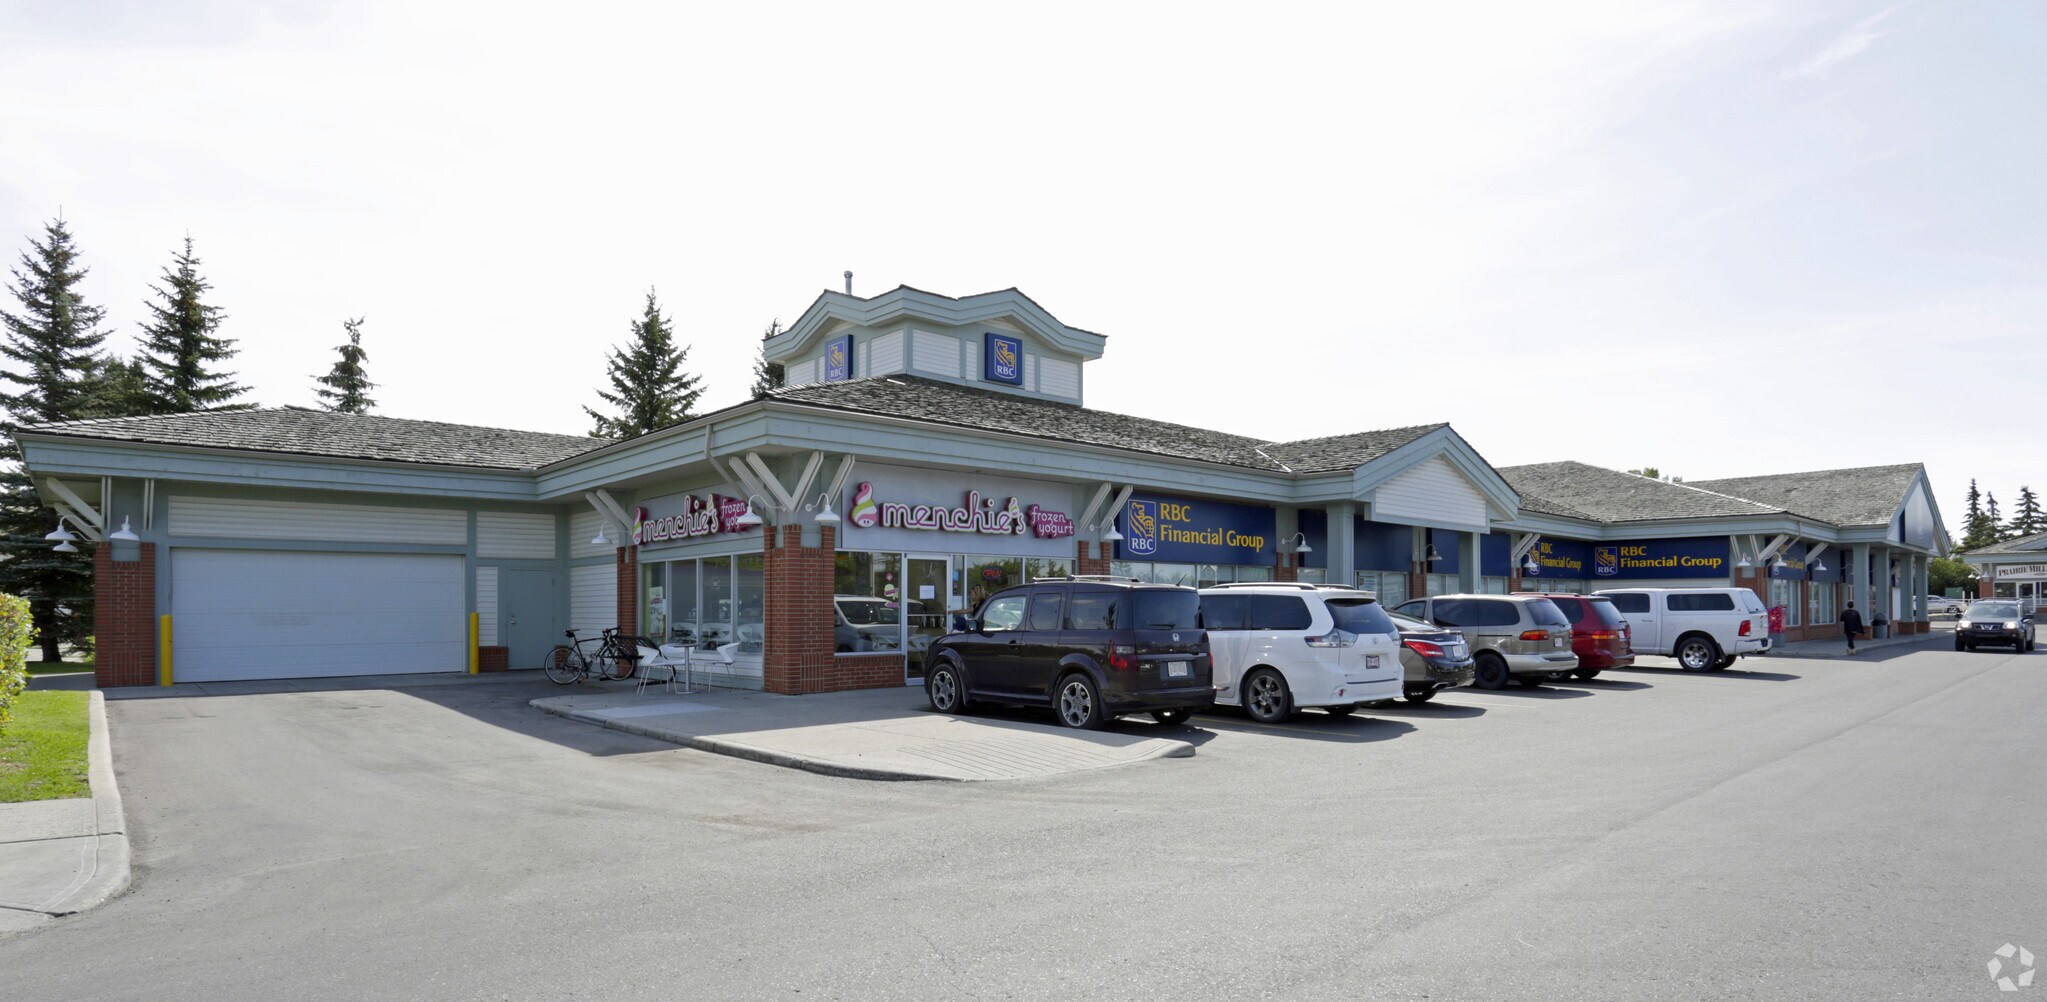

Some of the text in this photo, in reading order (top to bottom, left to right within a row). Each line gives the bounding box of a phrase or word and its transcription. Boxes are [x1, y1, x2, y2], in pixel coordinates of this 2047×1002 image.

[830, 367, 843, 378] RBC
[997, 365, 1014, 376] RBC
[721, 499, 746, 517] frozen
[882, 490, 1026, 535] menchie's
[1031, 506, 1066, 525] frozen
[1160, 503, 1192, 523] RBC
[643, 494, 719, 542] menchie's
[1038, 521, 1075, 536] yogurt
[1131, 538, 1154, 550] RBC
[1160, 524, 1265, 552] Financial Group
[1540, 542, 1553, 554] RBC
[1620, 546, 1647, 556] RBC
[1540, 555, 1582, 572] Financial Group
[1620, 556, 1722, 569] Financial Group
[1998, 566, 2028, 577] PRAIRIE
